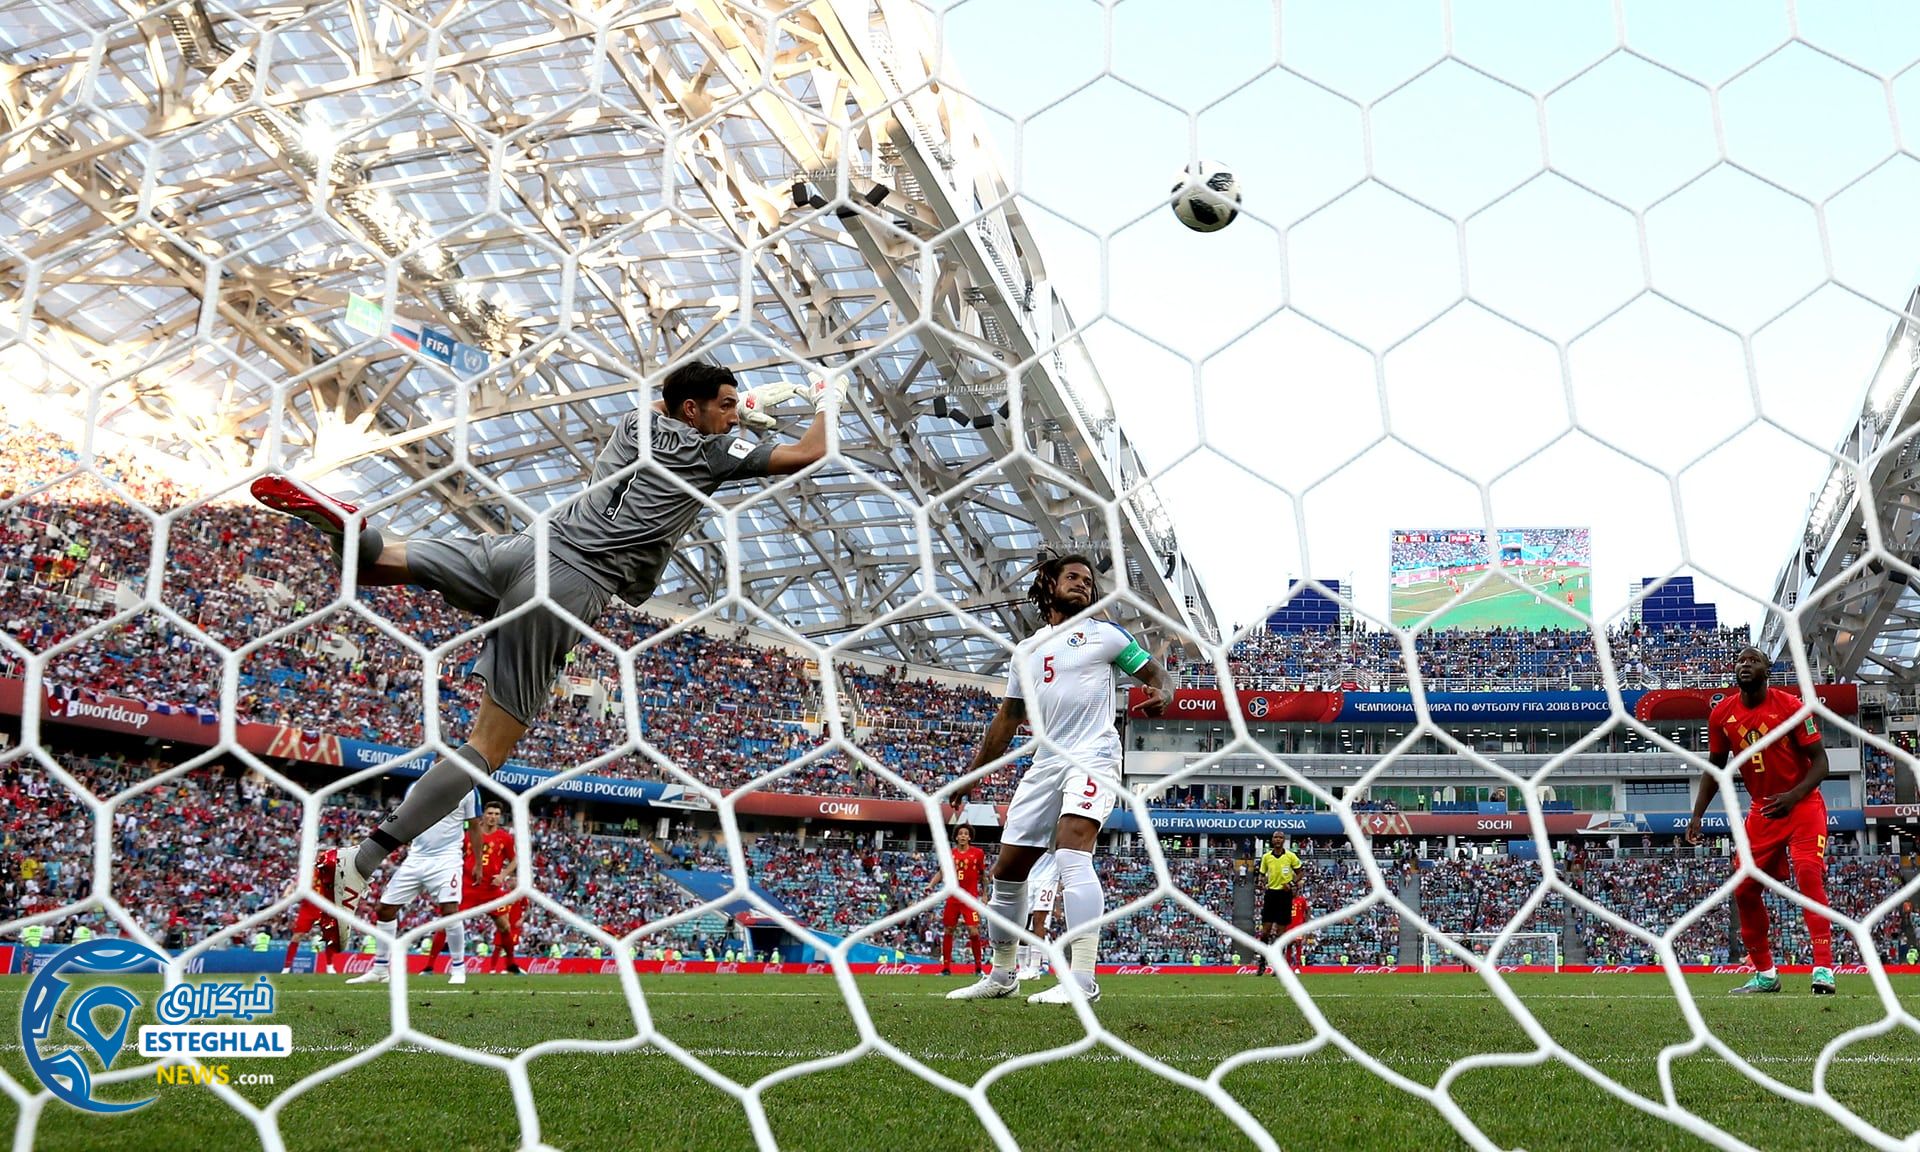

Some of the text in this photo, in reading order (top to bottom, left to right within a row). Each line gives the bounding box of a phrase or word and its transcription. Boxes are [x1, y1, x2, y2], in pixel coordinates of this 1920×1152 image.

[426, 337, 449, 355] FIFA
[1043, 656, 1055, 683] 5
[1179, 699, 1216, 711] СОЧИ
[1522, 702, 1545, 711] FIFA
[1546, 702, 1570, 711] 2018
[1751, 751, 1765, 773] 9
[557, 780, 583, 792] 2018
[819, 802, 860, 815] СОЧИ
[1151, 818, 1306, 829] 018 FIFA WORLD CUP RUSSIA
[1477, 820, 1512, 830] SOCHI
[1700, 817, 1725, 827] FIFA
[450, 874, 458, 889] 6
[1040, 889, 1054, 902] 20
